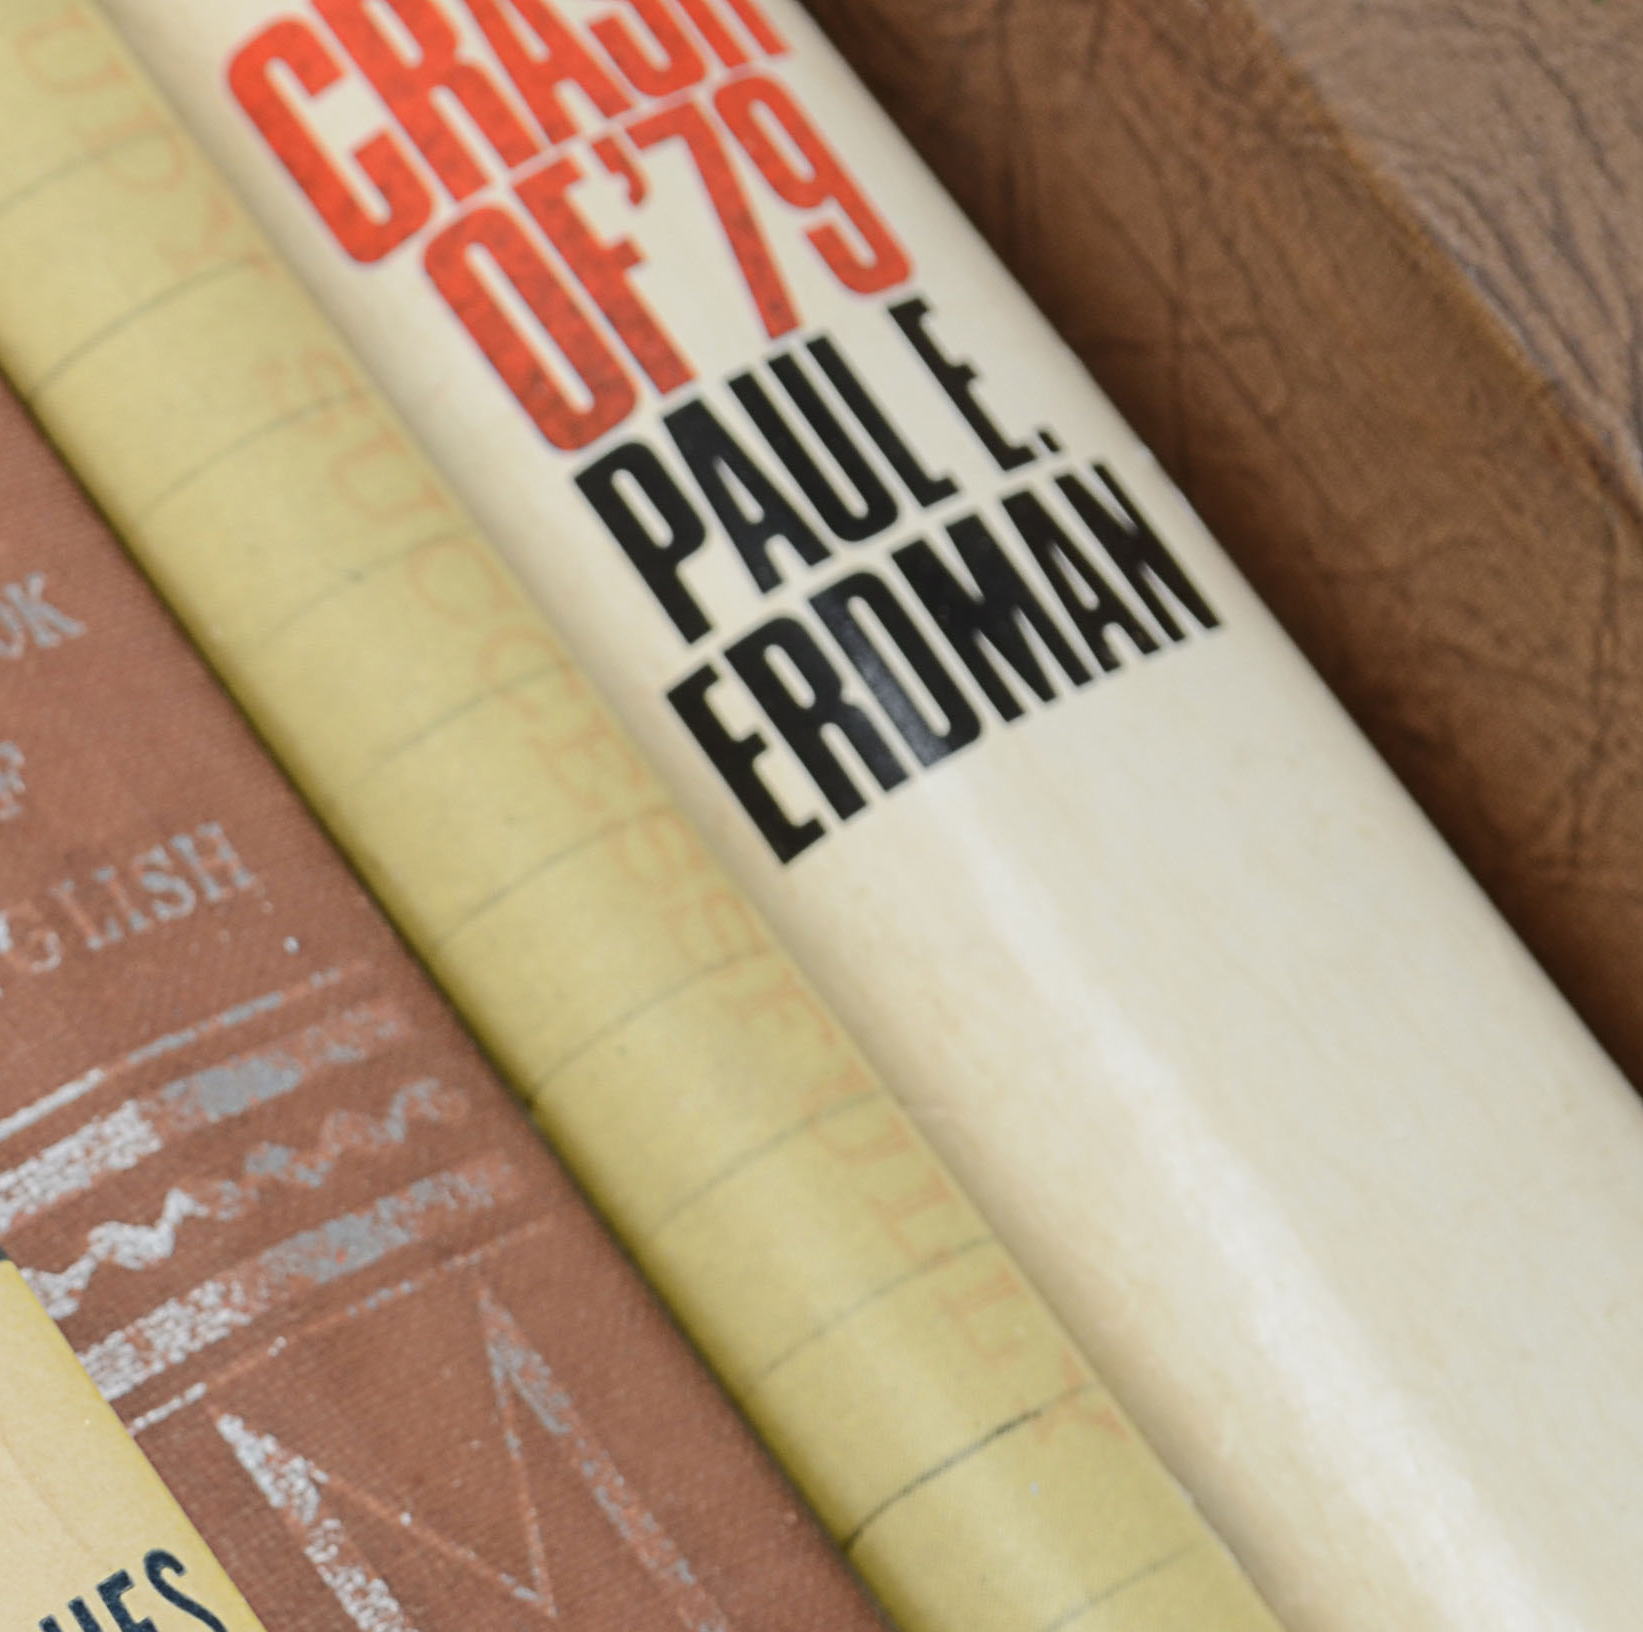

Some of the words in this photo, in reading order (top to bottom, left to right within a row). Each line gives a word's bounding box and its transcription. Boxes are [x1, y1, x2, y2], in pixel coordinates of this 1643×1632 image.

[573, 333, 961, 646] PAUL
[884, 294, 1064, 473] E.
[665, 459, 1224, 865] ERDMAN
